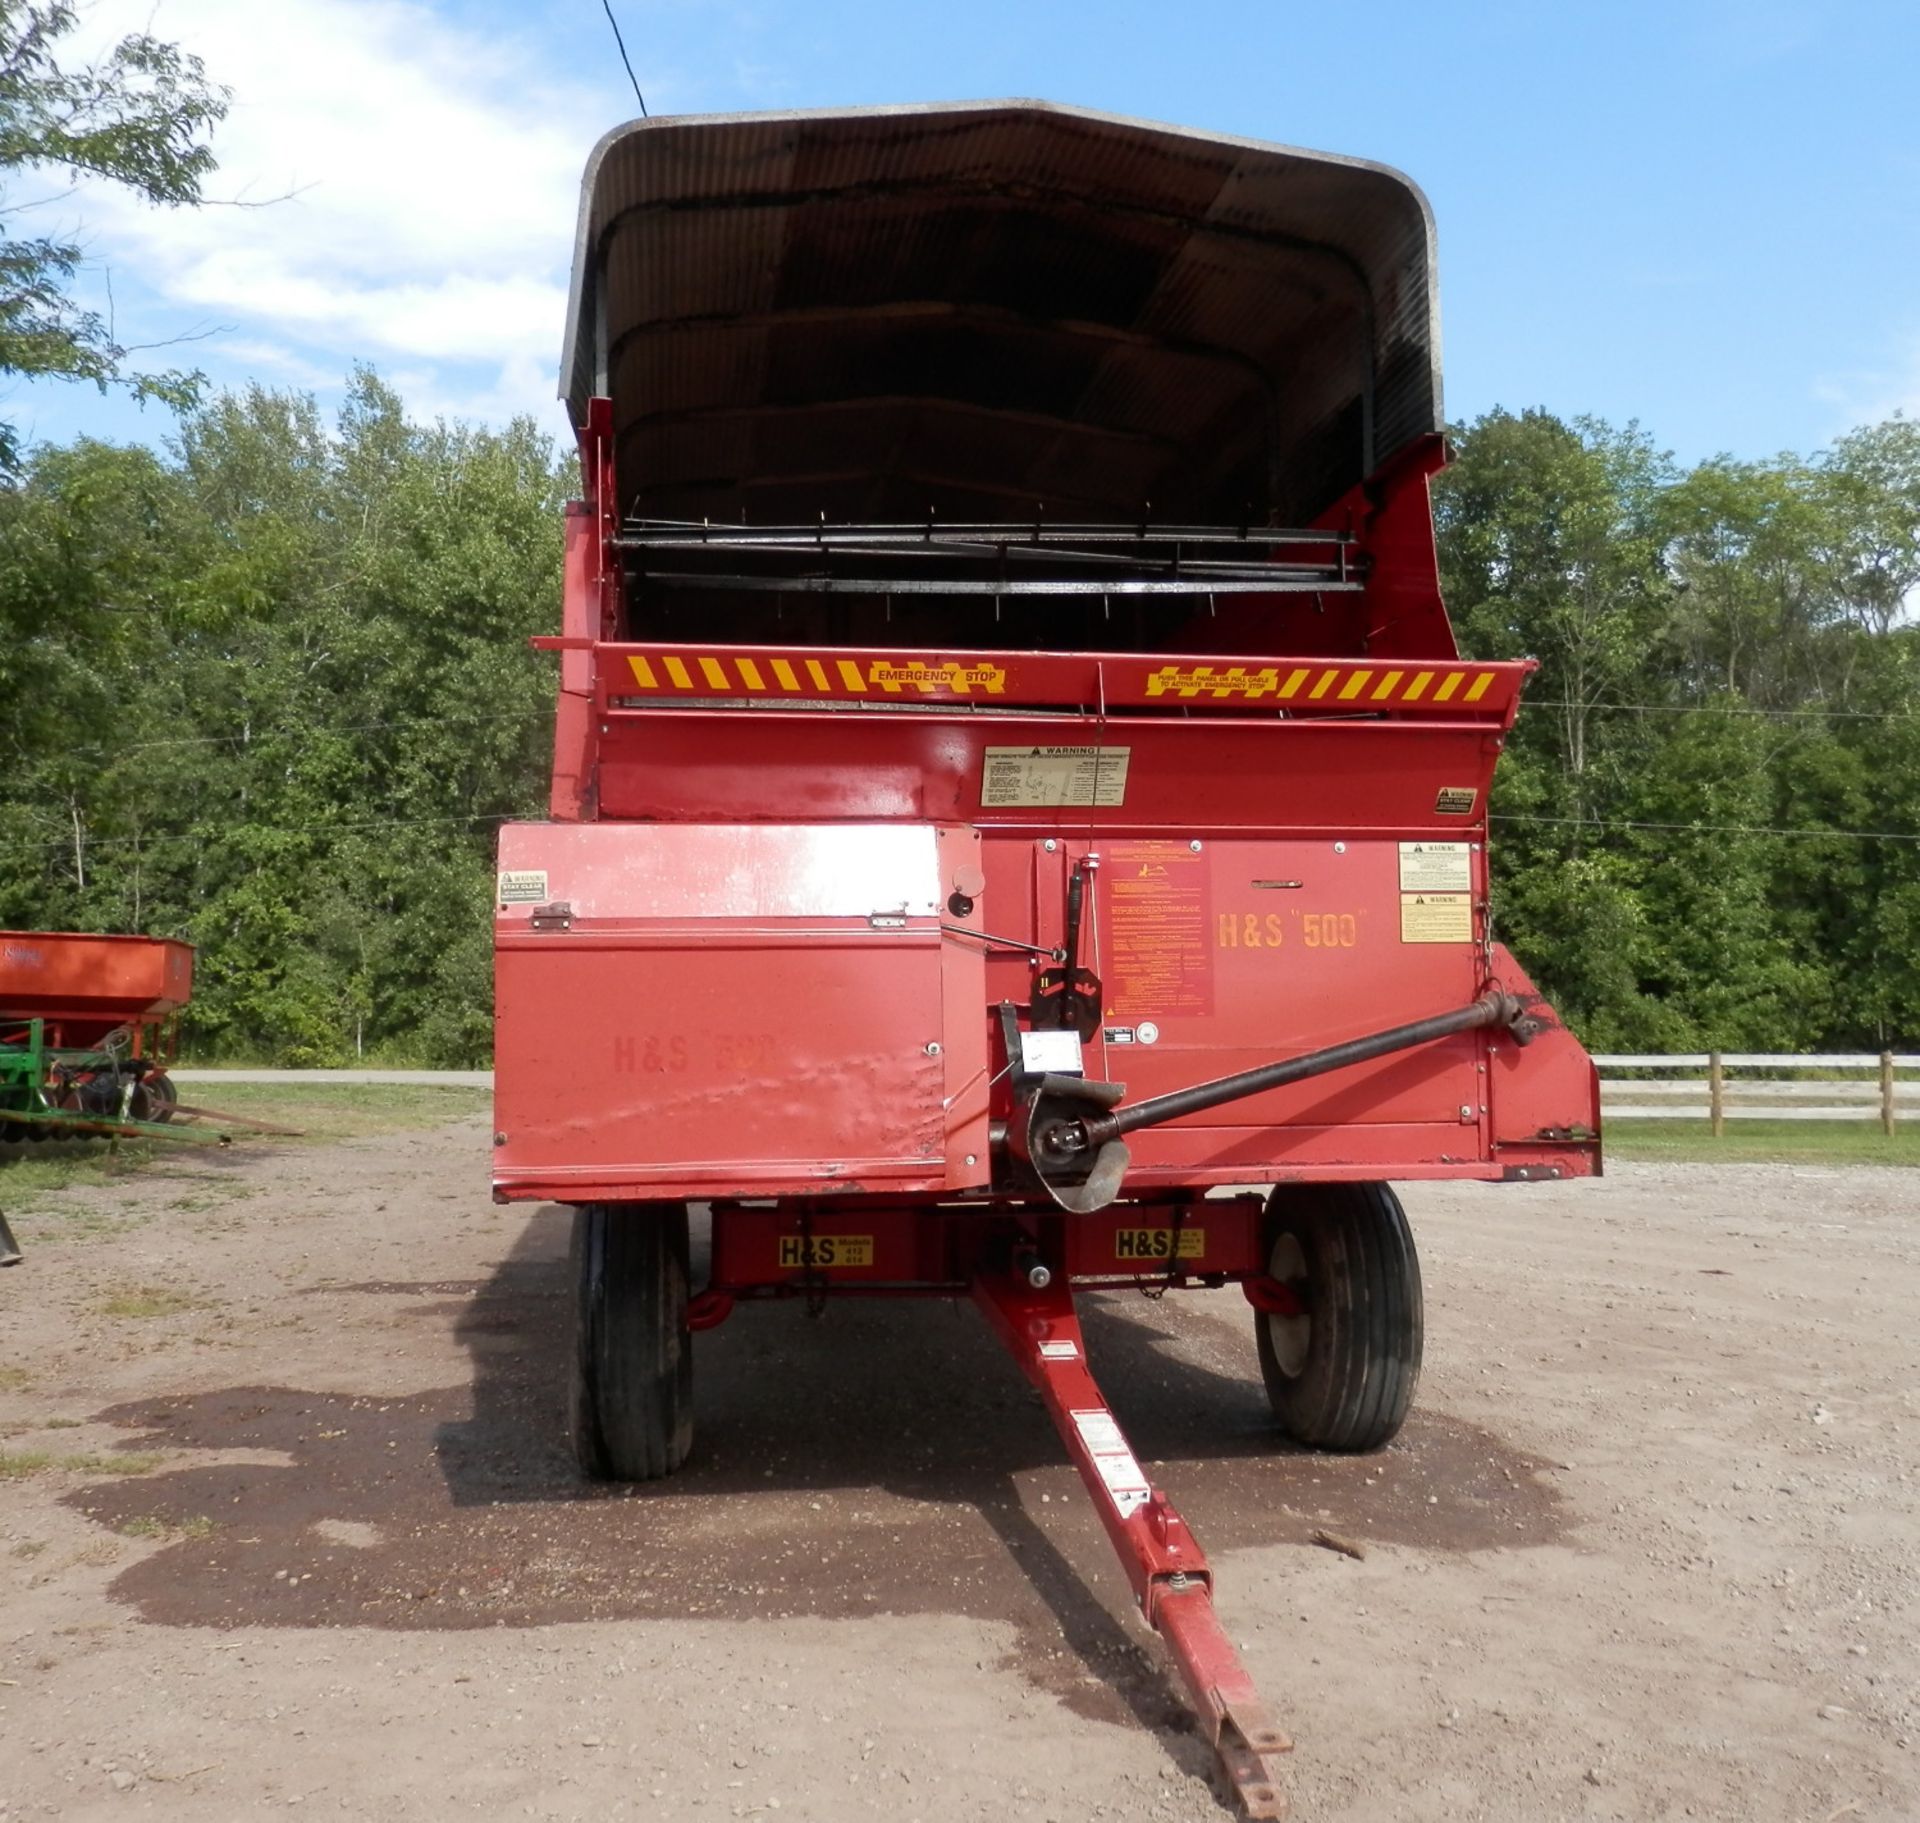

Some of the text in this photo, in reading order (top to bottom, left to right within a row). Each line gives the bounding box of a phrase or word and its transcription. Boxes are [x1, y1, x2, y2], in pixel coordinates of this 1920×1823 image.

[878, 670, 997, 682] EMERGENCY STOP
[1219, 913, 1282, 948] H&S
[614, 1034, 688, 1073] H&S
[781, 1238, 835, 1265] H&S
[1118, 1231, 1168, 1256] H&S
